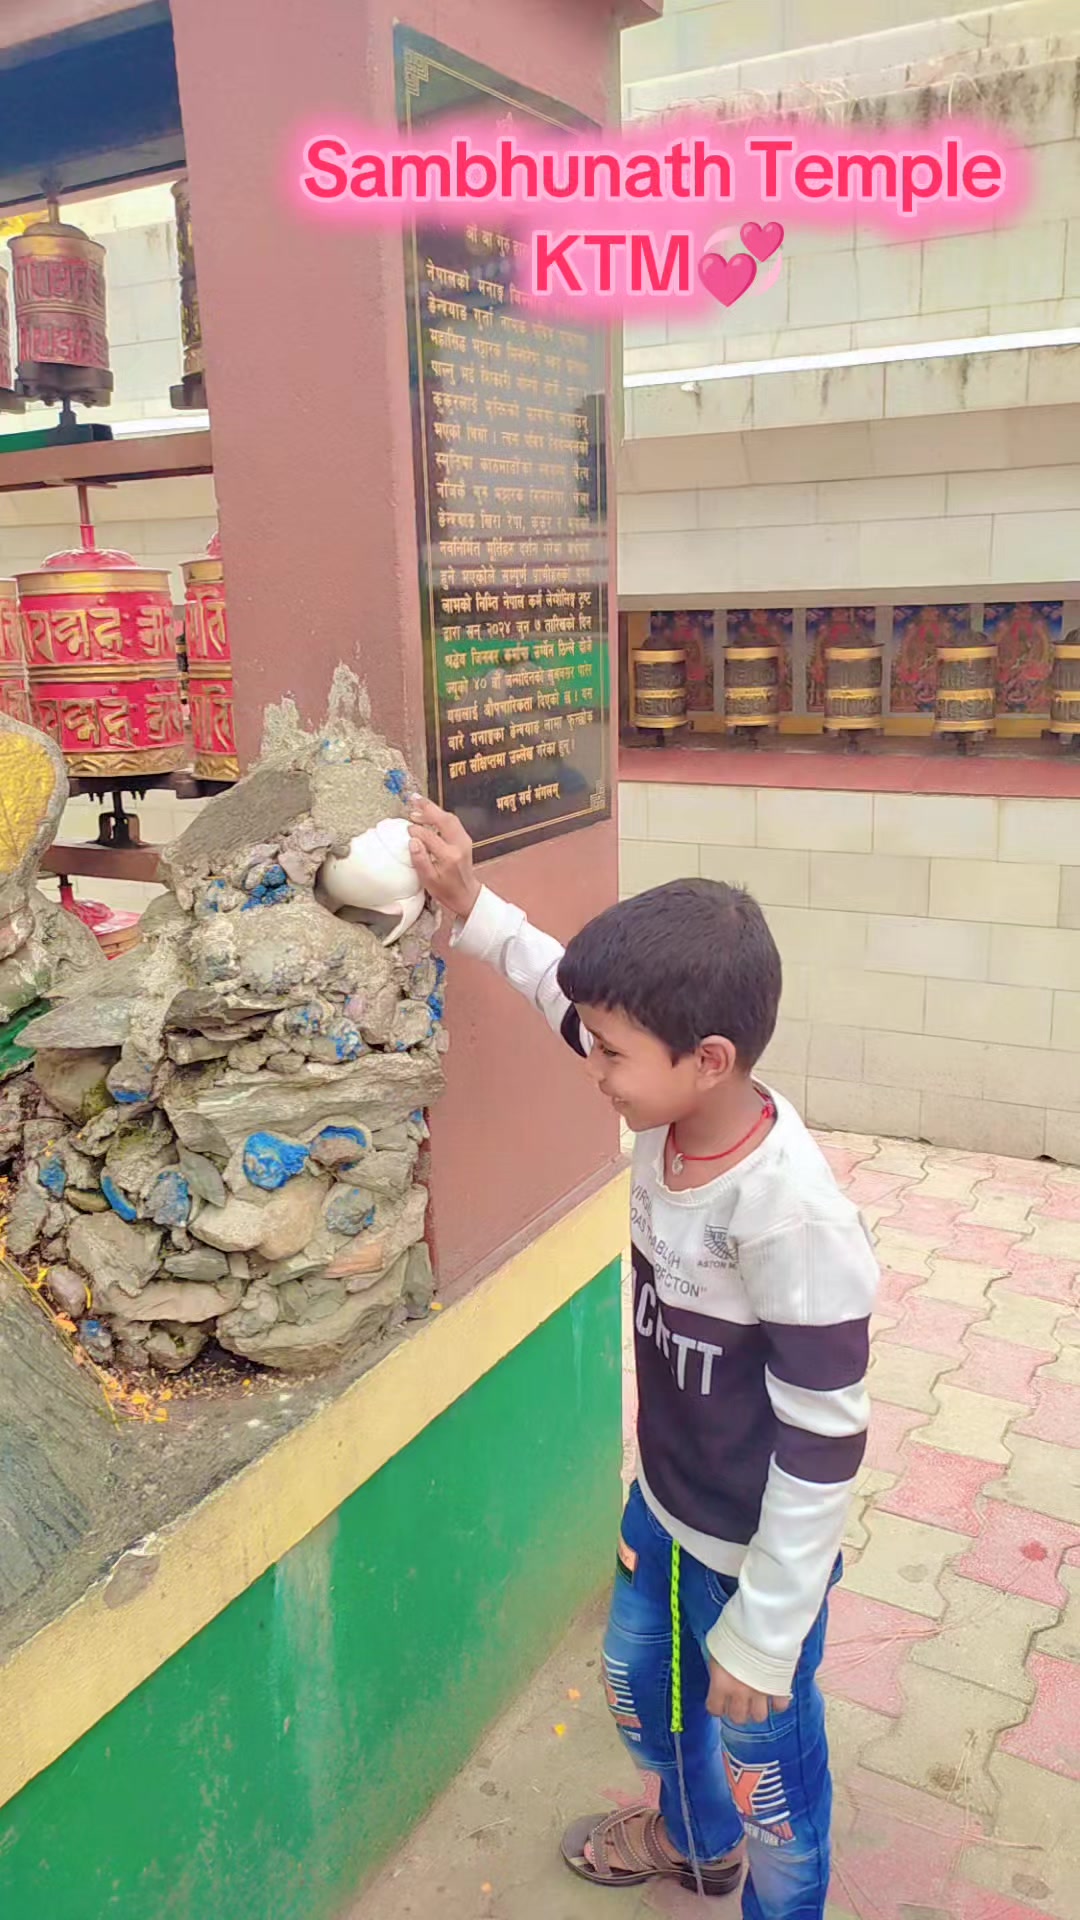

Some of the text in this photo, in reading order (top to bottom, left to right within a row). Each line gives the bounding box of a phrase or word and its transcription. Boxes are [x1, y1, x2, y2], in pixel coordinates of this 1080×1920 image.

[426, 260, 470, 290] नेपालको
[434, 423, 460, 442] भएको
[440, 537, 480, 556] नवनिर्मित
[520, 539, 538, 556] दर्शन
[440, 566, 455, 590] हुने
[462, 566, 495, 586] भएकोले
[501, 565, 526, 588] सम्पूर्ण
[441, 594, 472, 613] लाभको
[476, 592, 498, 611] निम्ति
[503, 592, 525, 609] नेपाल
[528, 590, 542, 608] कर्म
[442, 626, 461, 642] द्वारा
[466, 625, 482, 641] सन्
[486, 622, 511, 638] २०२४
[545, 614, 575, 633] तारिखको
[579, 613, 592, 630] दिन
[473, 678, 487, 691] ४०
[505, 668, 544, 686] जन्मदिनको
[447, 701, 478, 723] यसलाई
[484, 697, 532, 716] औपचारिकता
[538, 690, 560, 709] दिएको
[544, 717, 563, 730] लामा
[449, 761, 467, 779] द्वारा
[509, 745, 534, 764] उल्लेख
[536, 741, 556, 757] गरेका
[497, 783, 560, 812] भवतु सर्व मंगलम्
